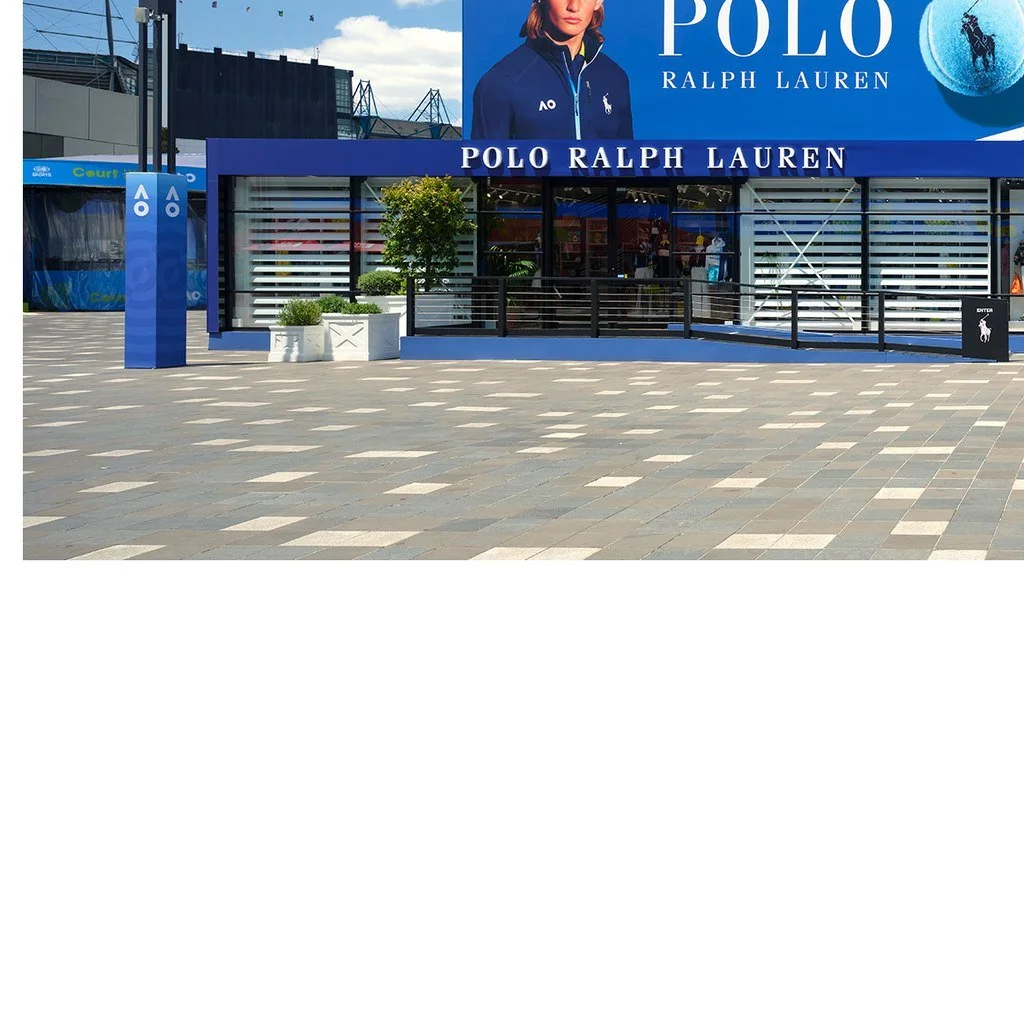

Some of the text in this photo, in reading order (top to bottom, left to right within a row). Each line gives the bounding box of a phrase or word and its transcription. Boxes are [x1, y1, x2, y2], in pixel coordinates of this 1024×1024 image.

[662, 72, 888, 89] RALPH LAUREN
[538, 99, 557, 112] AO
[460, 146, 846, 169] POLO RALPH LAUREN
[72, 167, 119, 179] Court
